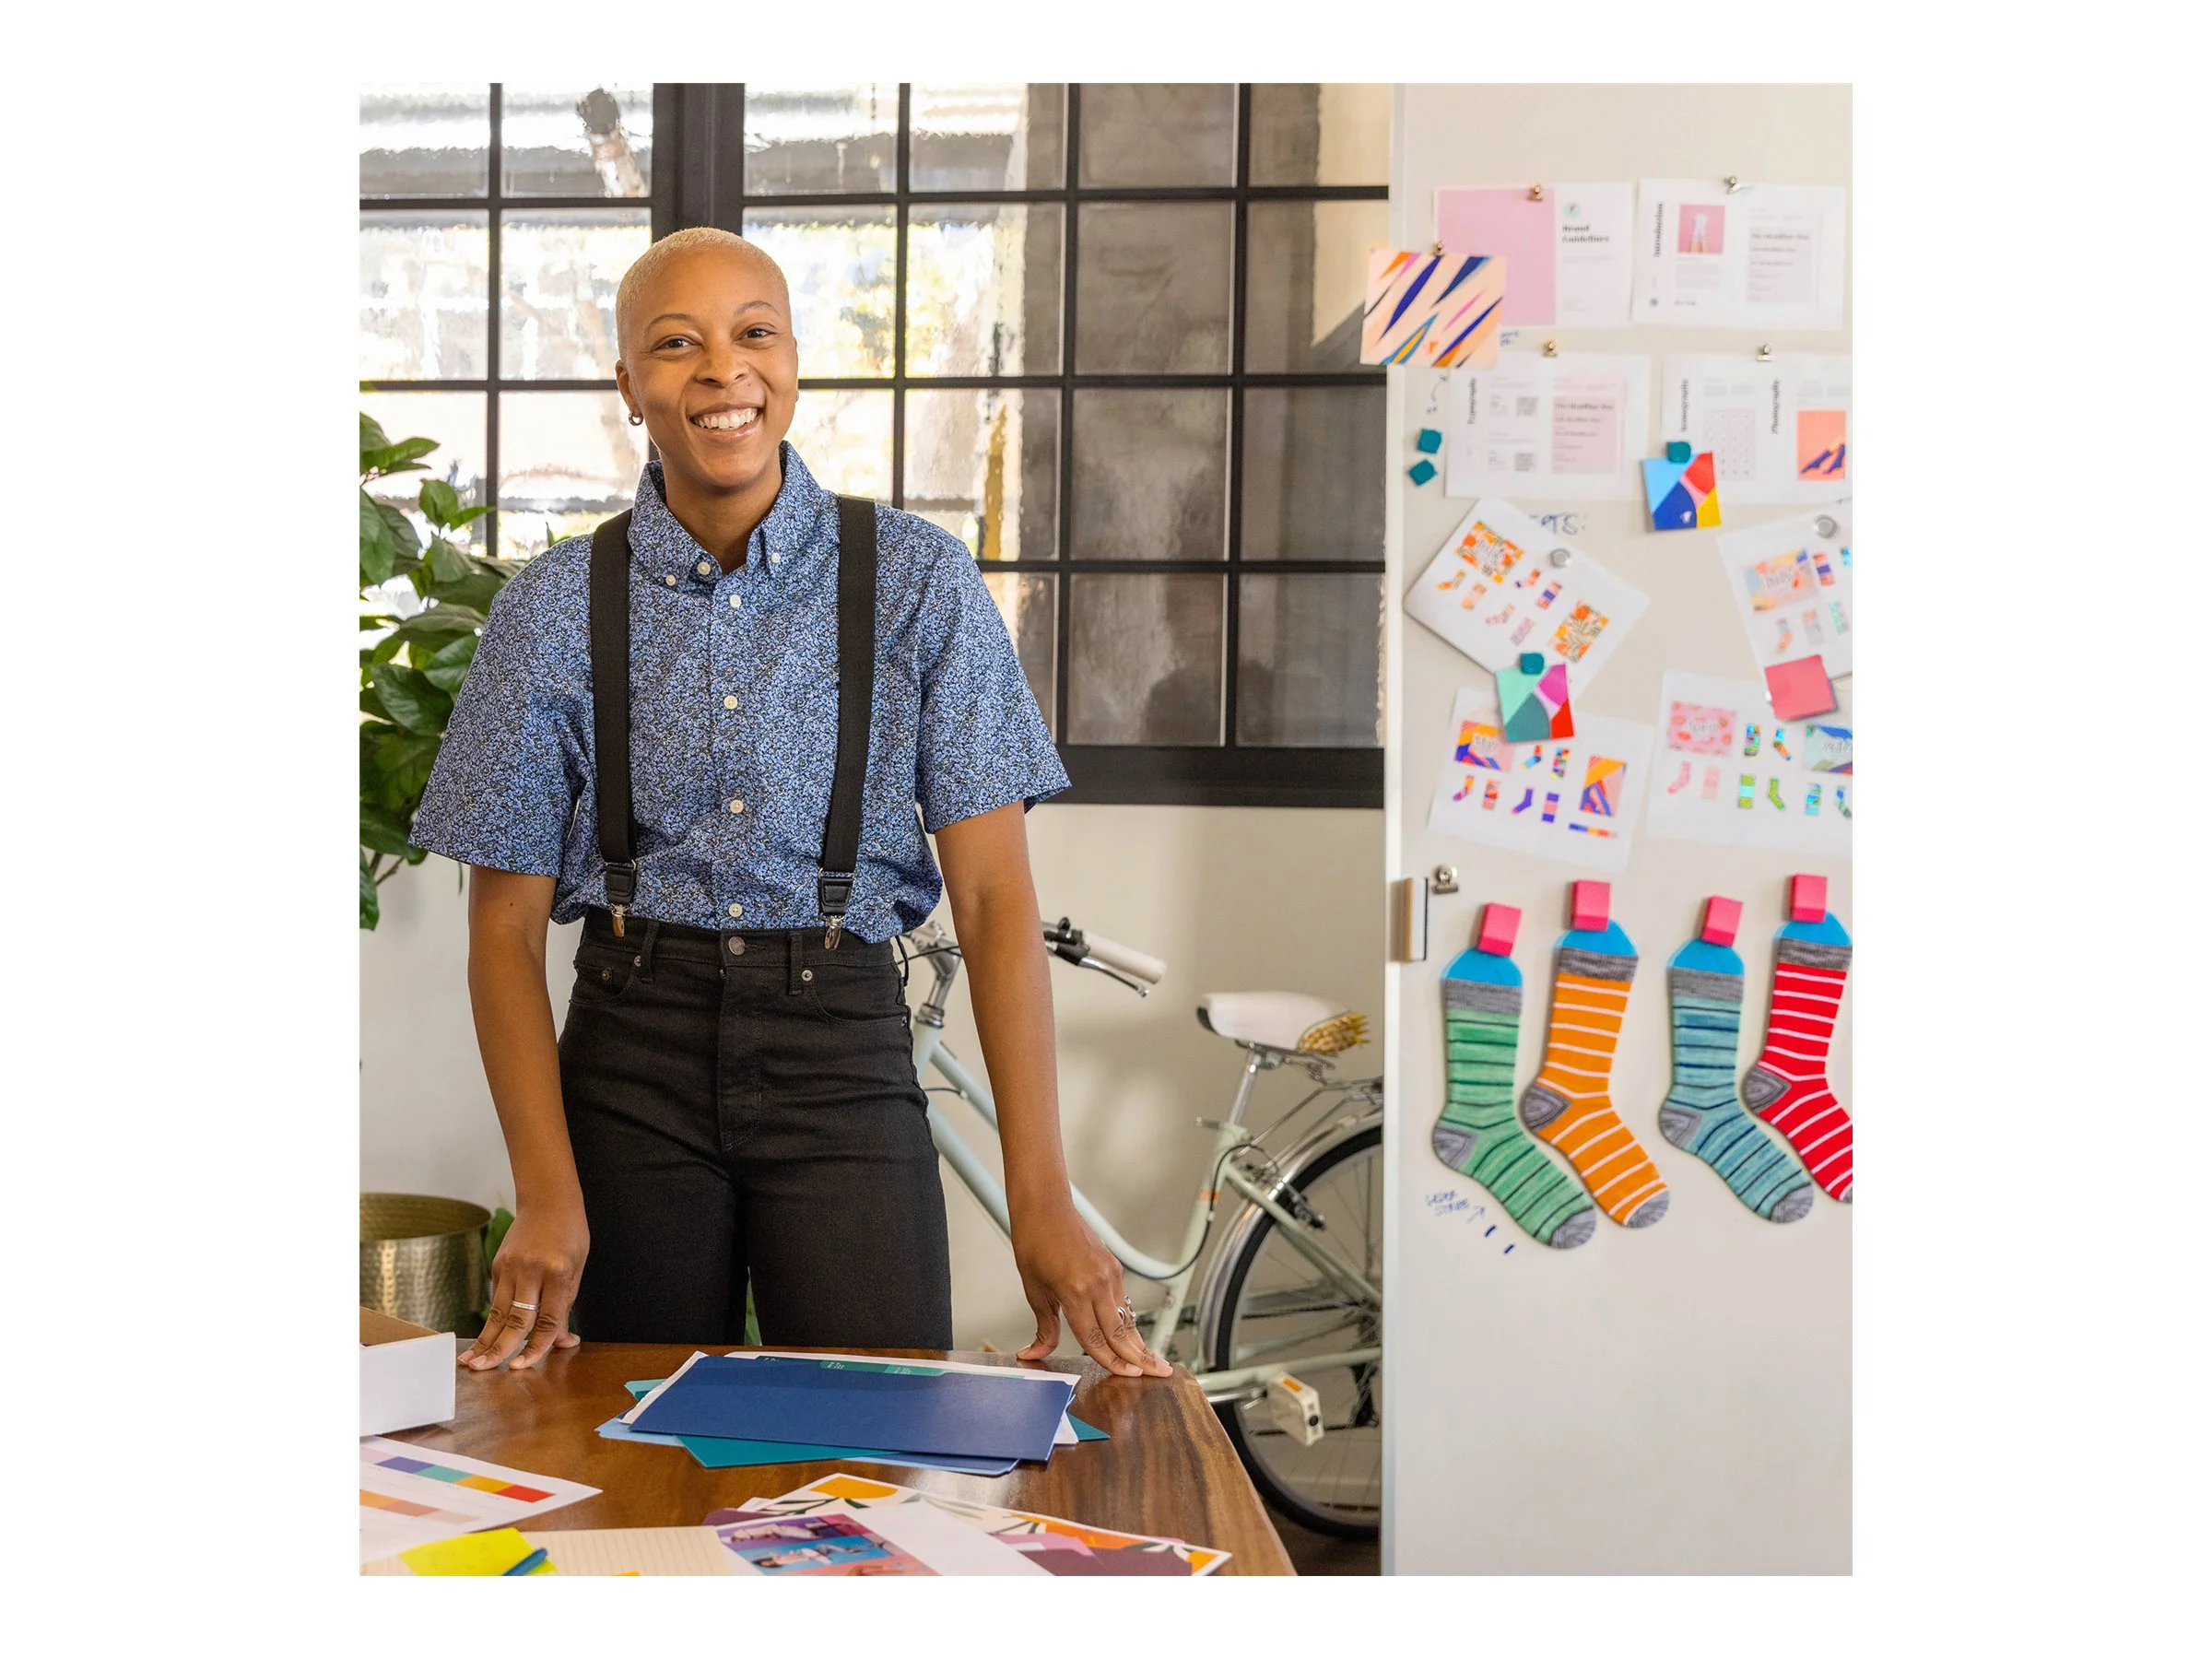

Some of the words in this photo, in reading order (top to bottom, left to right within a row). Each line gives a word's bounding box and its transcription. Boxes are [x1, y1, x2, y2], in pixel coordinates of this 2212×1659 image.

[1562, 234, 1609, 243] Guidelines
[1653, 202, 1664, 257] Introduction
[1771, 379, 1781, 435] Photography
